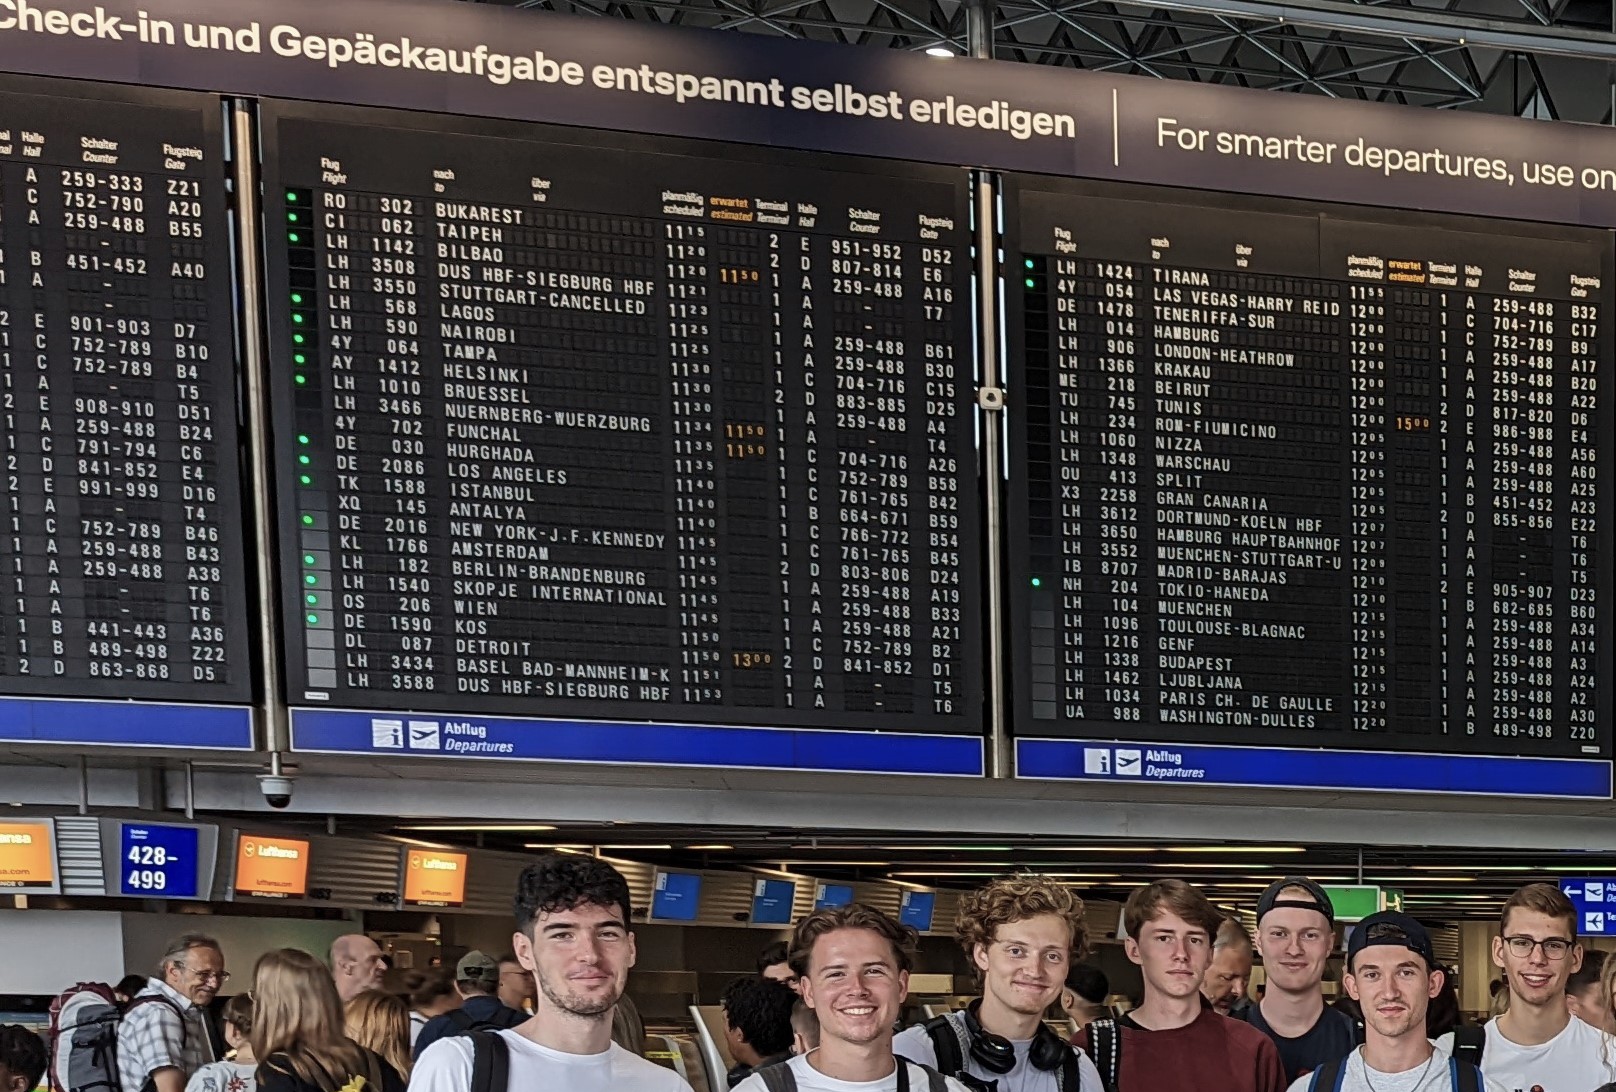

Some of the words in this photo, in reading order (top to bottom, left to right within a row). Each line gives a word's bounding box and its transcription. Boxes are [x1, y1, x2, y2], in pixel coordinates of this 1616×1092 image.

[0, 0, 175, 44] Check-in
[184, 22, 260, 53] und
[270, 25, 584, 85] Gepäckaufgabe
[592, 65, 784, 107] entspannt
[792, 84, 903, 119] selbst
[910, 96, 1075, 139] erledigen
[80, 136, 119, 151] Schalter
[1158, 118, 1209, 150] For
[1217, 132, 1337, 163] smarter
[1345, 138, 1513, 185] departures,
[1523, 162, 1574, 186] use
[83, 151, 119, 165] Counter
[62, 171, 142, 191] 259-333
[167, 180, 199, 196] Z21
[64, 192, 143, 212] 752-790
[169, 201, 200, 217] A20
[436, 203, 522, 224] BUKAREST
[437, 223, 502, 242] TAIPEH
[438, 243, 502, 262] BILBAO
[439, 263, 470, 279] DUS
[483, 268, 612, 292] HBF-SIEGBURG
[624, 280, 654, 295] HBF
[1153, 268, 1209, 286] TIRANA
[440, 284, 644, 314] STUTTGART-CANCELLED
[1154, 288, 1182, 304] LAS
[1192, 290, 1294, 313] VEGAS-HARRY
[1303, 301, 1341, 317] REID
[441, 304, 494, 321] LAGOS
[71, 316, 150, 335] 901-903
[175, 323, 195, 338] D7
[441, 323, 515, 343] NAIROBI
[1155, 325, 1219, 342] HAMBURG
[443, 343, 497, 361] TAMPA
[1155, 344, 1294, 367] LONDON-HEATHROW
[444, 364, 527, 383] HELSINKI
[1155, 362, 1210, 379] KRAKAU
[445, 383, 530, 403] BRUESSEL
[1156, 399, 1201, 415] TUNIS
[1156, 436, 1202, 451] NIZZA
[1156, 455, 1230, 471] WARSCHAU
[449, 463, 479, 478] LOS
[493, 466, 566, 484] ANGELES
[1157, 492, 1194, 507] GRAN
[1203, 494, 1269, 511] CANARIA
[453, 561, 645, 585] BERLIN-BRANDENBURG
[1158, 565, 1286, 584] MADRID-BARAJAS
[1158, 582, 1270, 601] TOKIO-HANEDA
[457, 639, 530, 655] DETROIT
[1160, 655, 1232, 670] BUDAPEST
[1160, 709, 1314, 728] WASHINGTON-DULLES
[445, 722, 487, 740] Abflug
[445, 739, 514, 757] Departures
[1146, 750, 1182, 766] Abflug
[1146, 764, 1205, 779] Departures
[128, 846, 178, 866] 428-
[128, 870, 166, 890] 499
